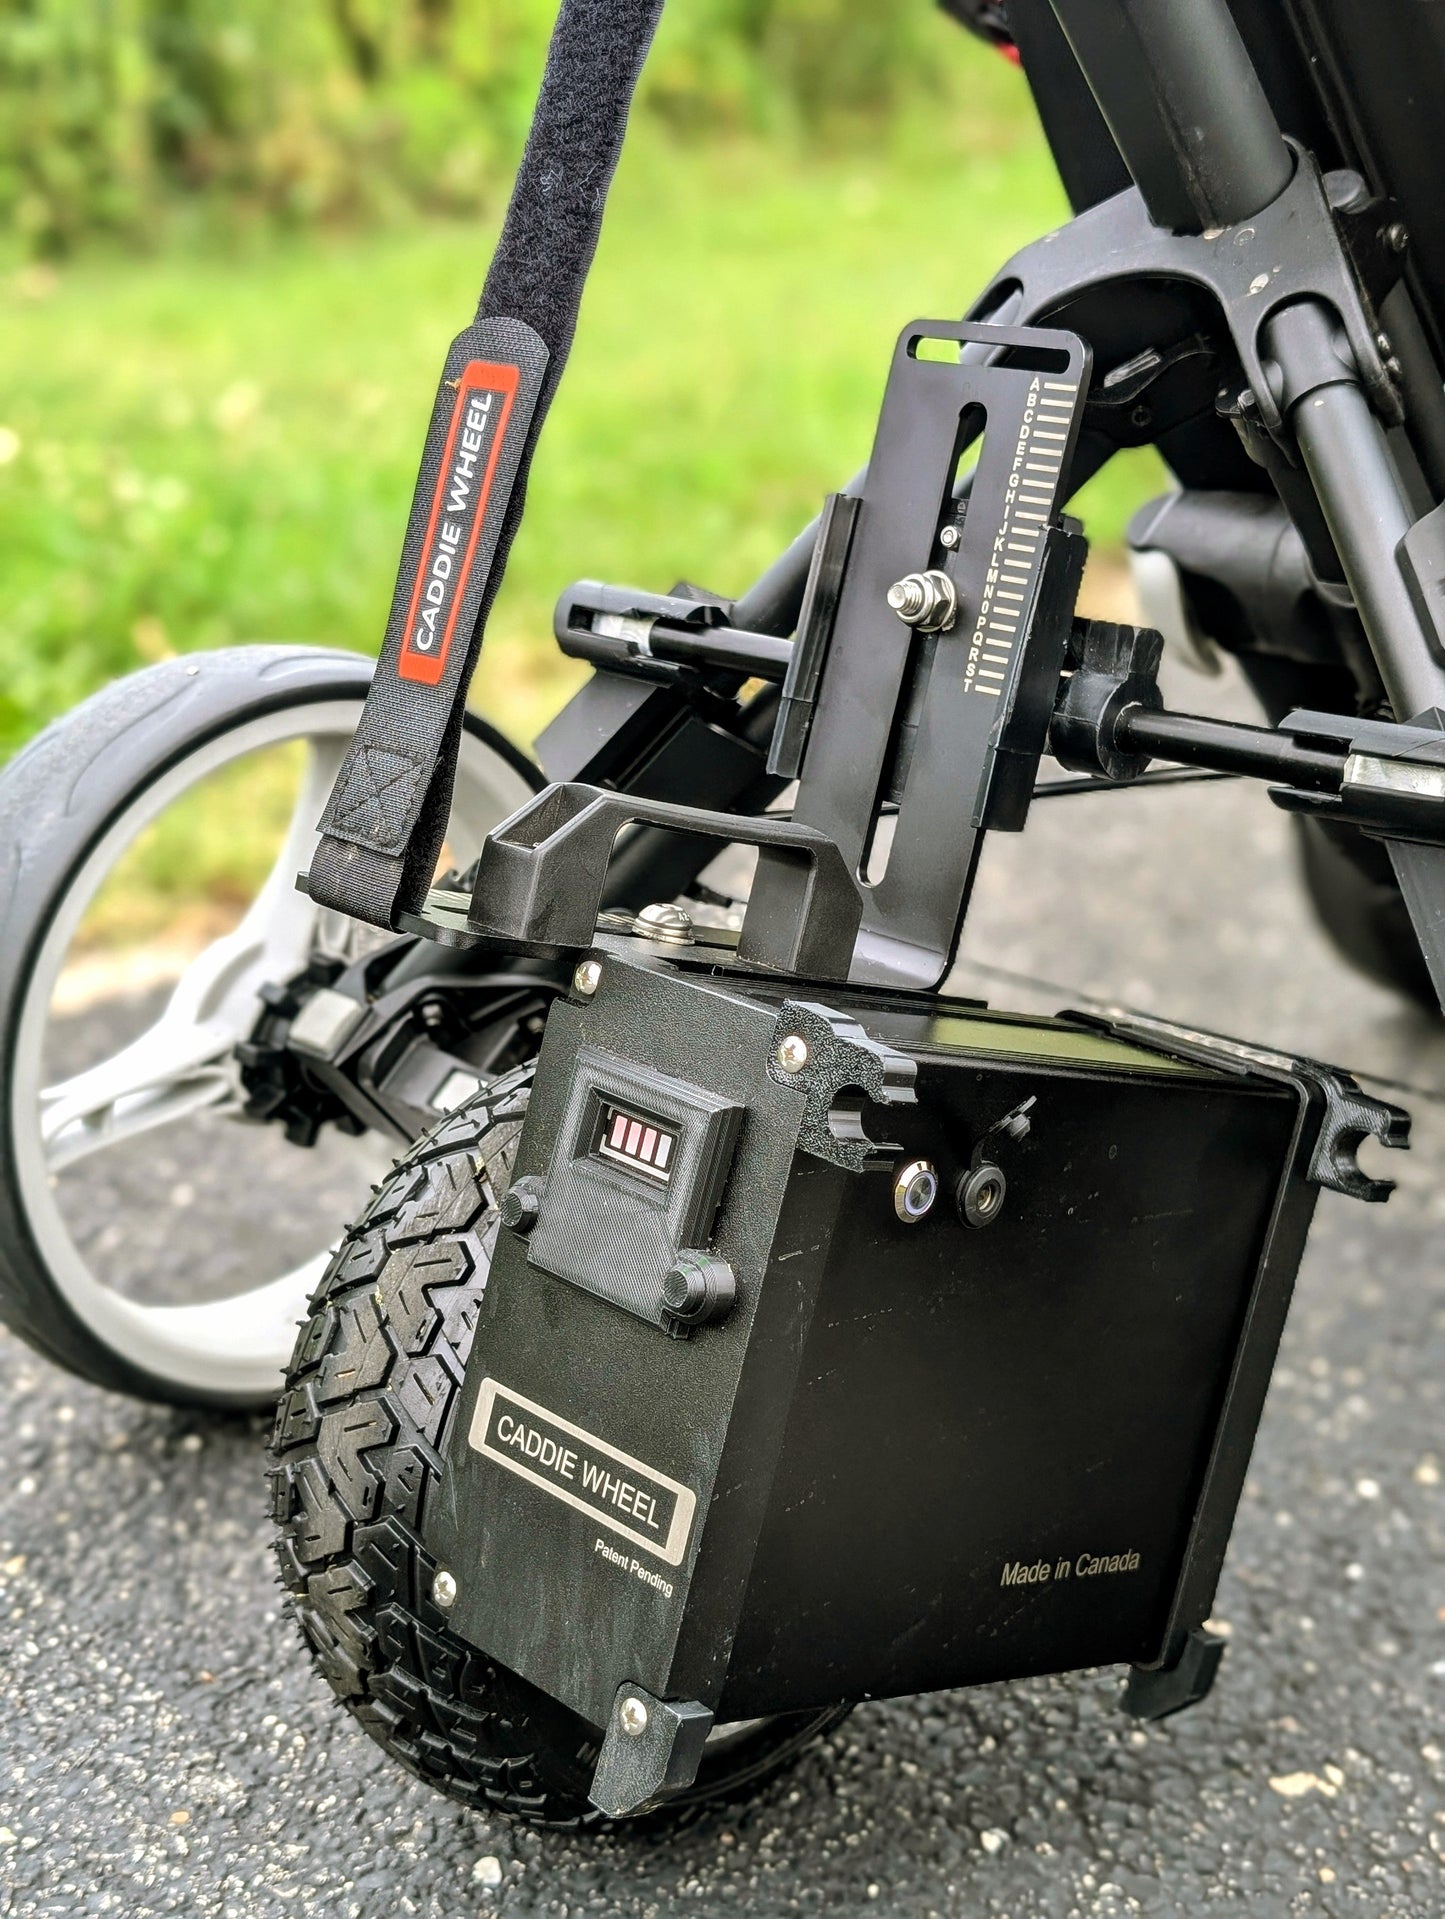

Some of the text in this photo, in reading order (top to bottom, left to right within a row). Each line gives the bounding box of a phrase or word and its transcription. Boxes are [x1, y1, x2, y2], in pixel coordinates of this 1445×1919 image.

[1029, 376, 1040, 392] A
[1026, 392, 1037, 408] B
[1023, 408, 1034, 424] C
[1019, 424, 1030, 440] D
[1015, 440, 1027, 456] E
[1012, 457, 1023, 472] F
[1008, 473, 1020, 488] G
[1005, 488, 1016, 504] H
[416, 392, 493, 650] CADDIE WHEEL
[998, 520, 1008, 536] J
[993, 536, 1005, 552] K
[990, 552, 999, 568] L
[986, 568, 998, 584] M
[983, 584, 994, 600] N
[976, 615, 987, 630] P
[972, 631, 984, 647] Q
[968, 647, 980, 662] R
[965, 662, 976, 678] S
[963, 678, 973, 693] T
[497, 1415, 660, 1530] CADDIE WHEEL
[594, 1538, 674, 1599] Patent Pending
[1000, 1548, 1141, 1586] Made in Canada
